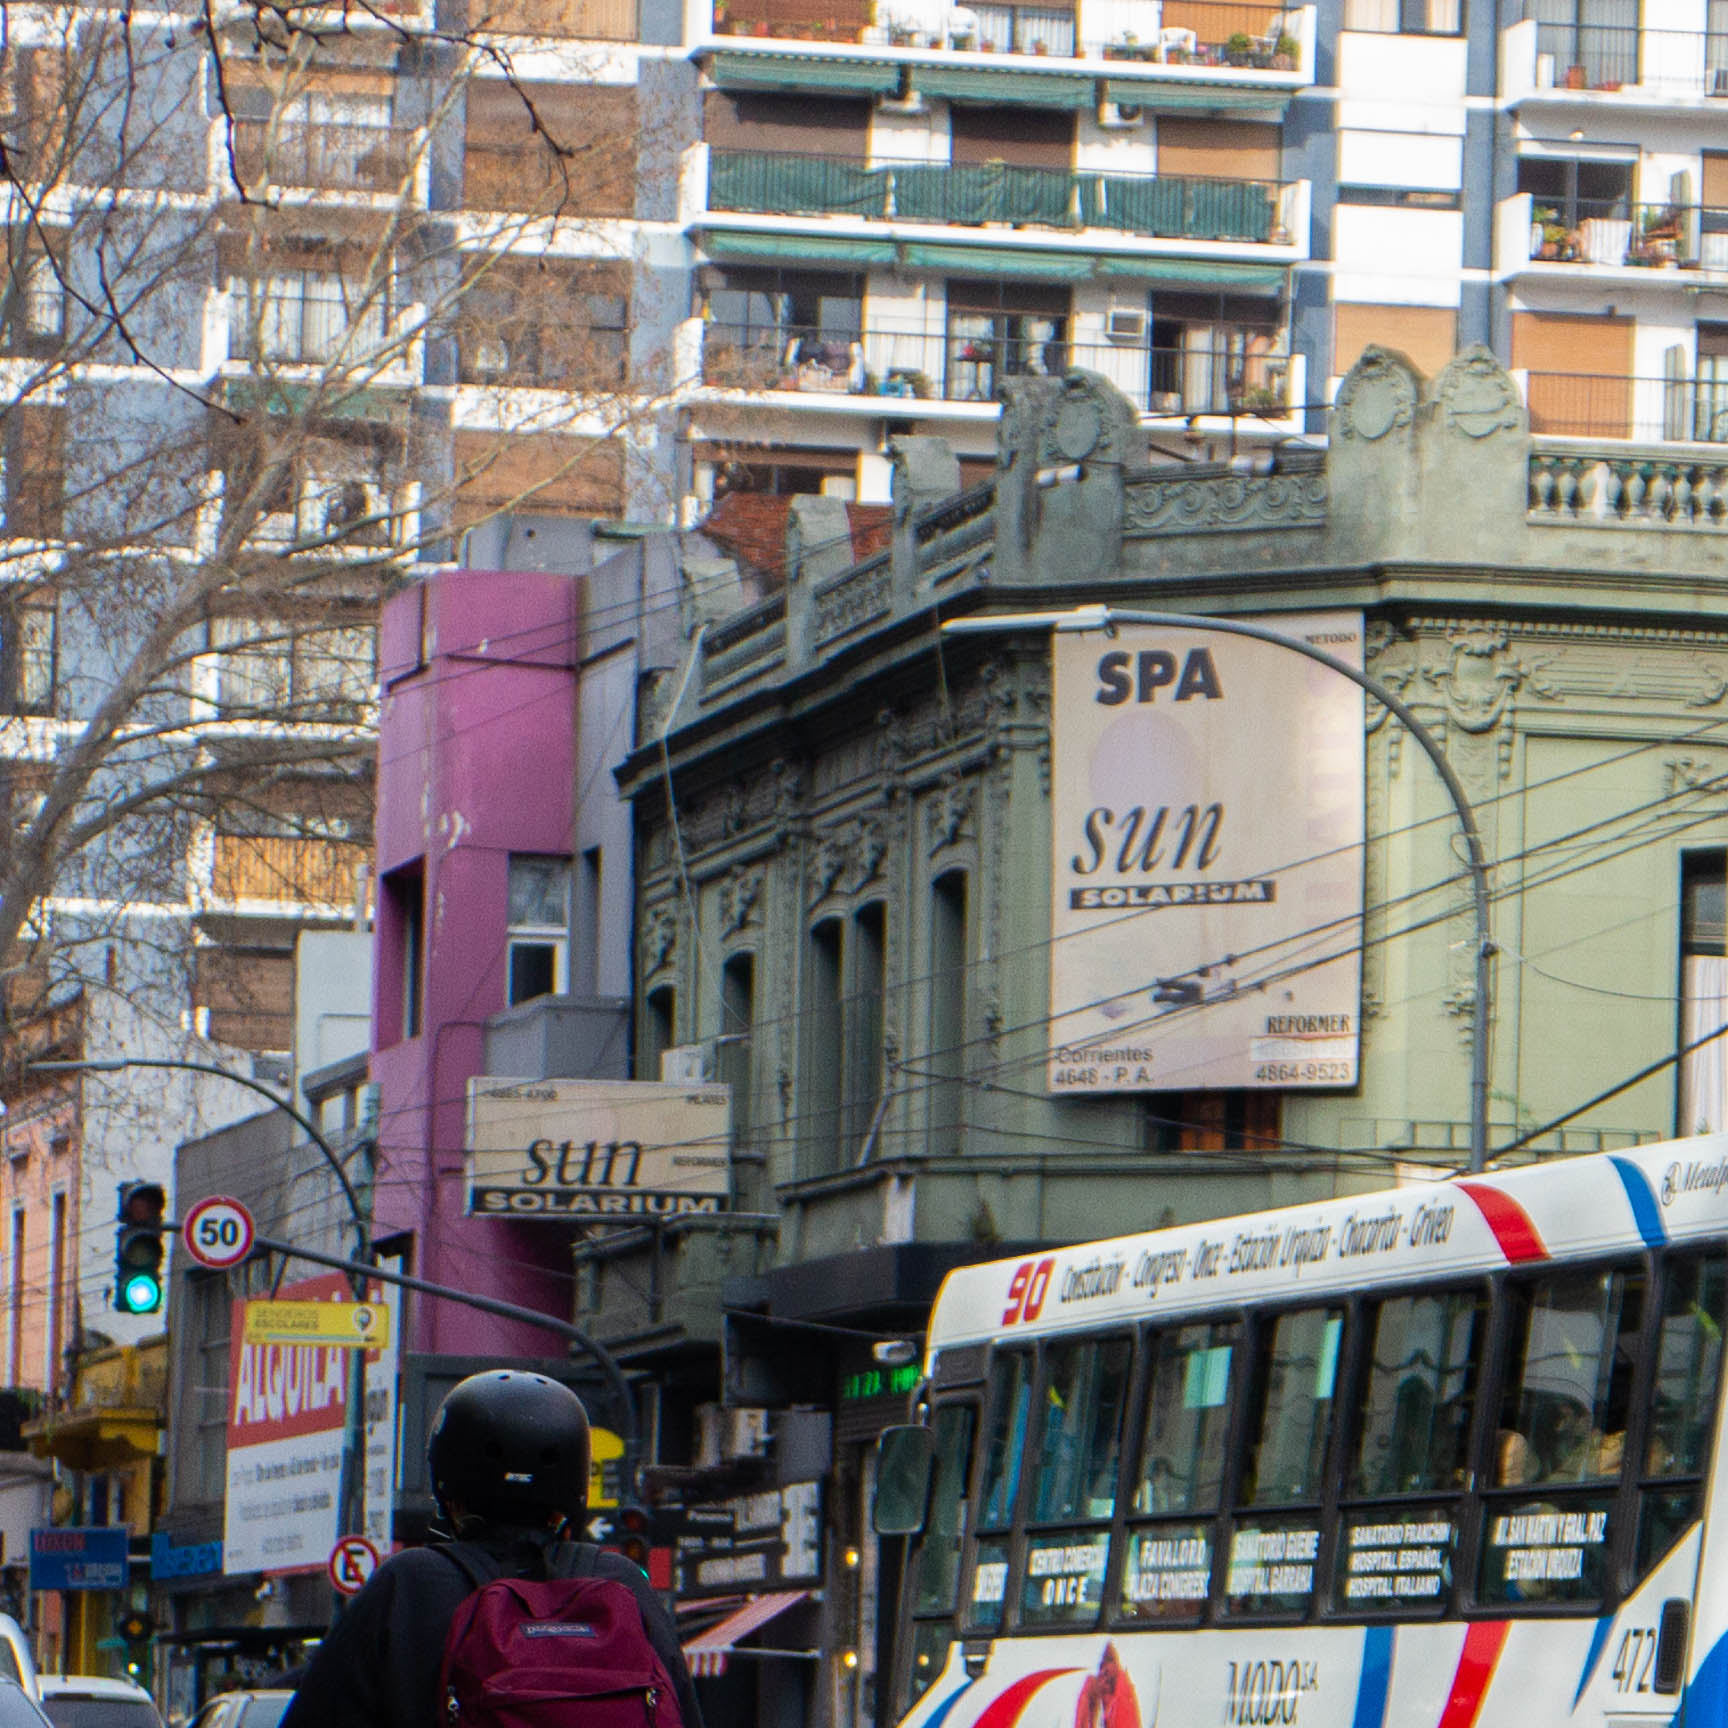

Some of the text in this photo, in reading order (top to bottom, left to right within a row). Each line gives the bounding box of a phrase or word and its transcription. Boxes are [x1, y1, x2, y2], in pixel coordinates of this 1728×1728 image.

[1096, 648, 1223, 706] SPA
[1072, 801, 1225, 874] sun
[1082, 882, 1267, 907] SOLARIUM
[1267, 1014, 1351, 1034] REFORMER
[1058, 1047, 1153, 1064] Corrientes
[523, 1138, 642, 1187] sun
[483, 1192, 719, 1213] SOLARIUM
[200, 1218, 238, 1246] 50
[1002, 1258, 1056, 1327] 90
[234, 1340, 345, 1427] ALQUILA
[1139, 1539, 1207, 1568] FAVALORO
[1041, 1575, 1089, 1606] ONCE
[1613, 1629, 1657, 1693] 472
